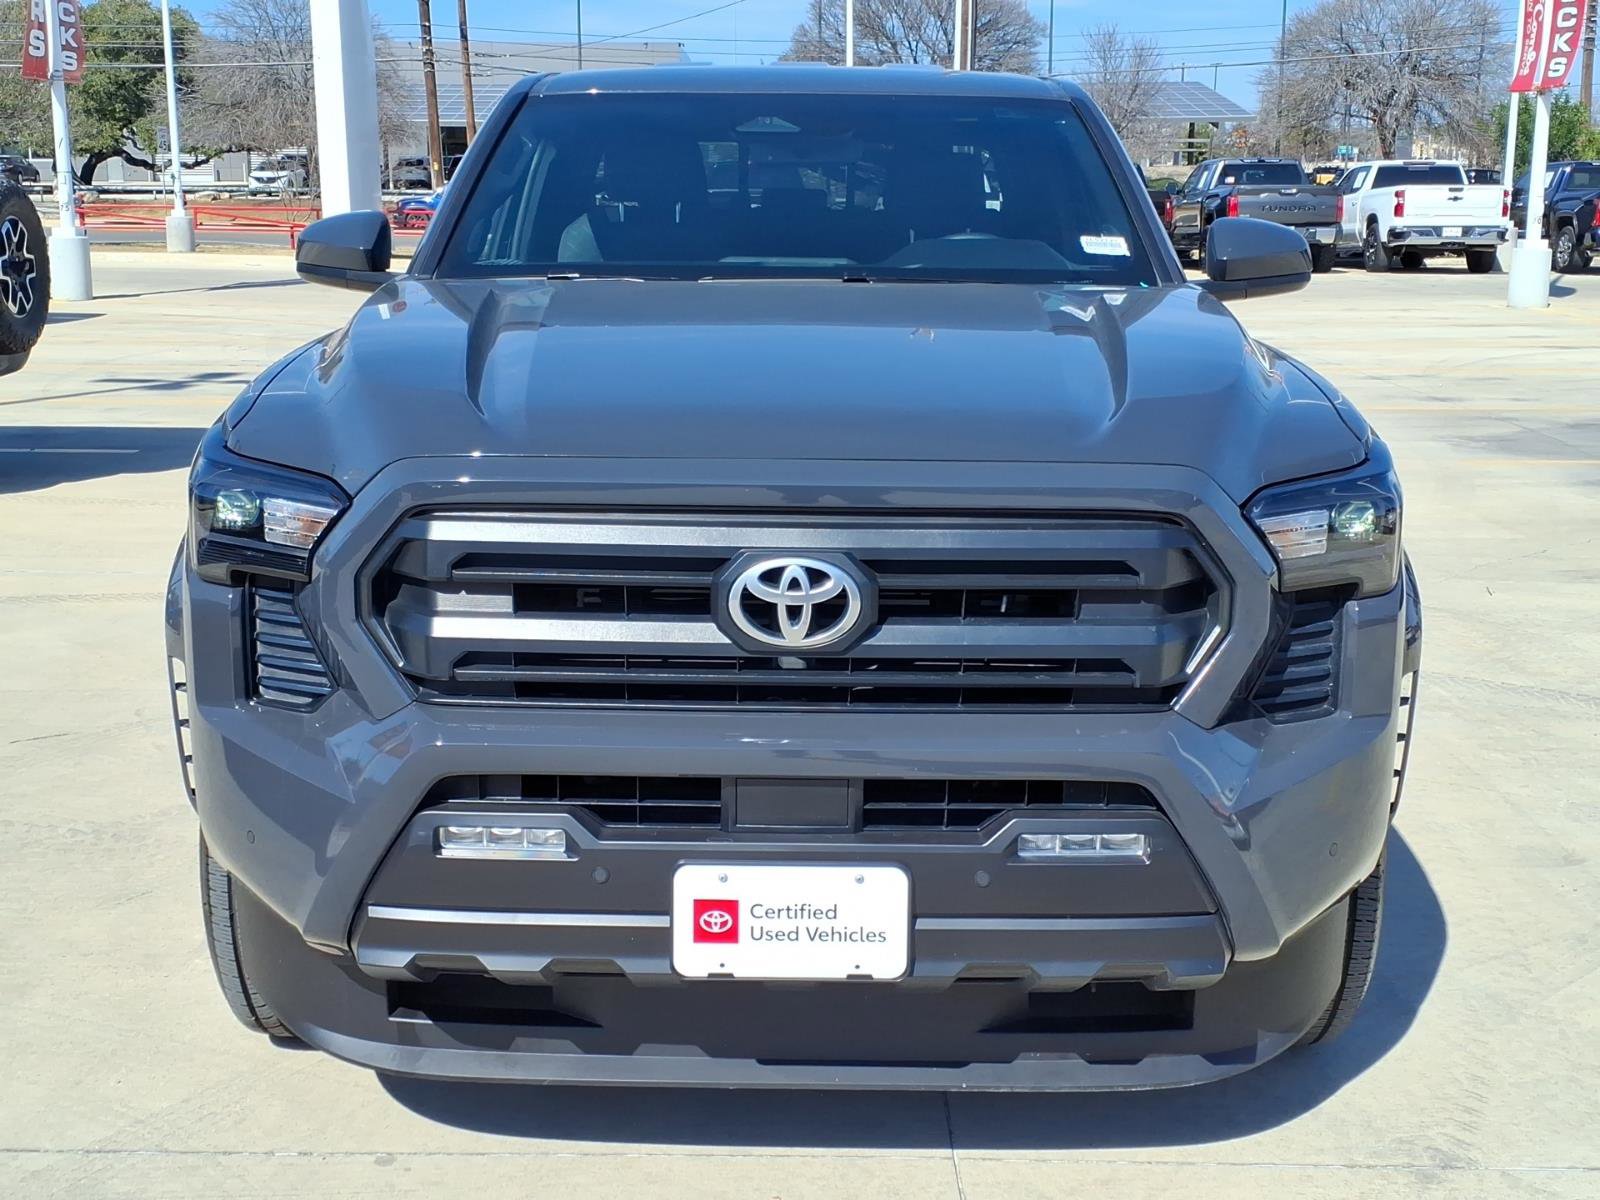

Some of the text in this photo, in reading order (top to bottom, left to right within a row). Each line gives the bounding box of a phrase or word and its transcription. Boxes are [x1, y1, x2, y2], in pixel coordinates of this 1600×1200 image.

[58, 2, 78, 71] CKS
[1523, 3, 1544, 76] Combs
[1547, 0, 1578, 78] CKS
[749, 903, 838, 920] Certified
[749, 926, 887, 943] Used Vehicles
